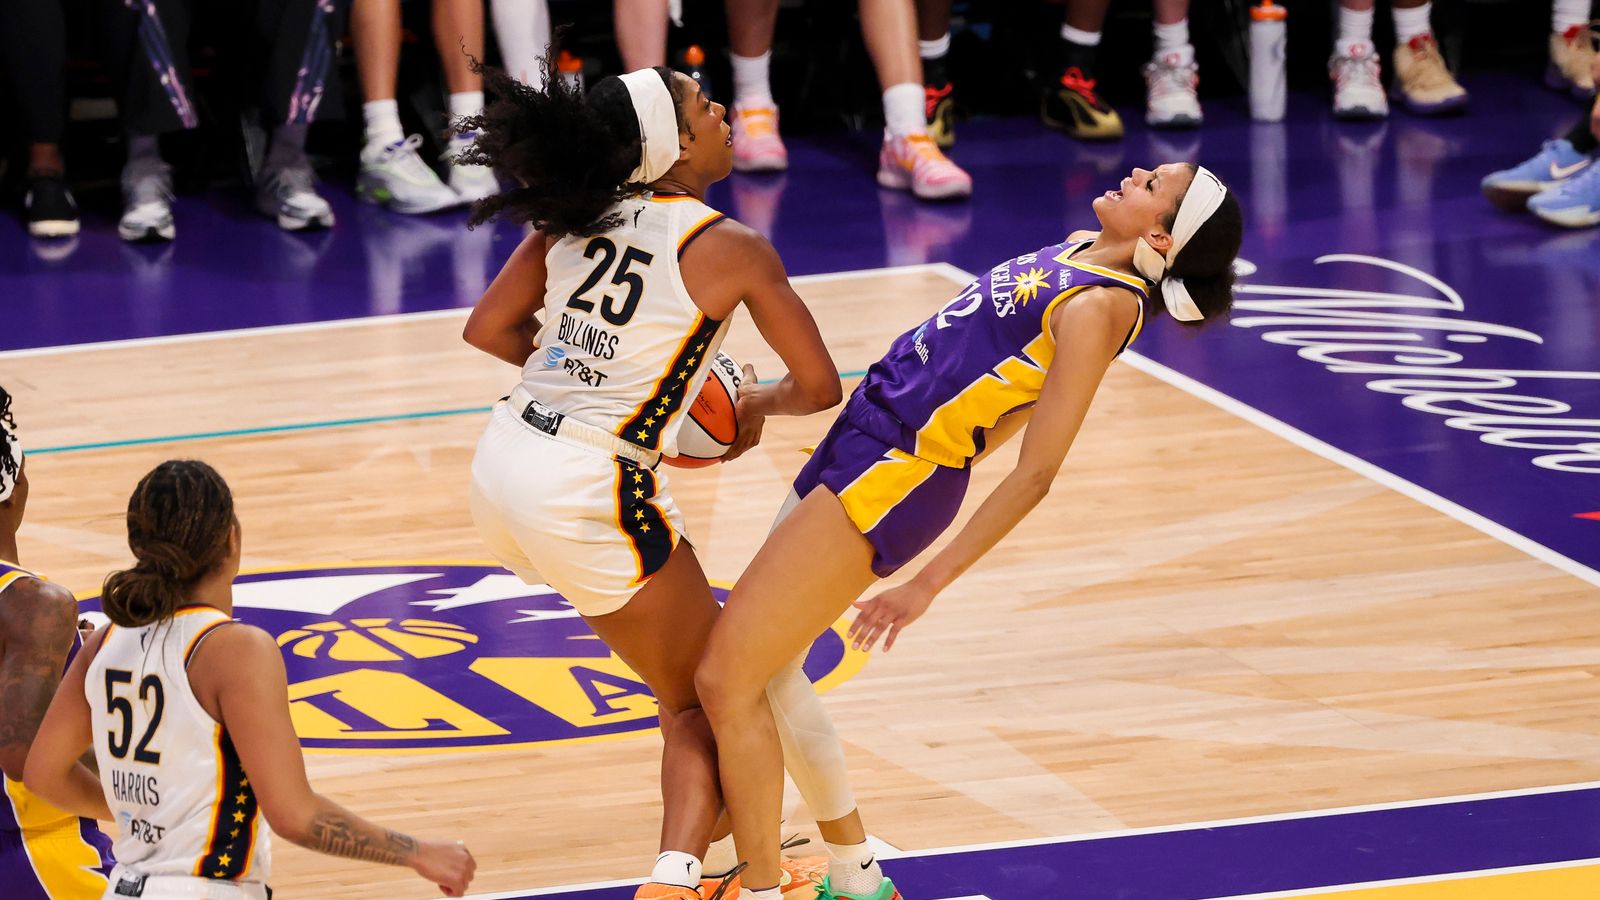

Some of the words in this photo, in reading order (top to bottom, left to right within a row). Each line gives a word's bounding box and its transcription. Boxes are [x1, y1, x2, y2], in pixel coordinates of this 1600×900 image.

[566, 236, 654, 326] 25
[1016, 253, 1038, 265] OS
[936, 281, 983, 330] 12
[991, 260, 1016, 318] NGELES
[558, 312, 619, 360] BILLINGS
[563, 358, 608, 387] AT&T
[105, 668, 164, 765] 52
[112, 769, 160, 807] HARRIS
[131, 818, 166, 844] AT&T
